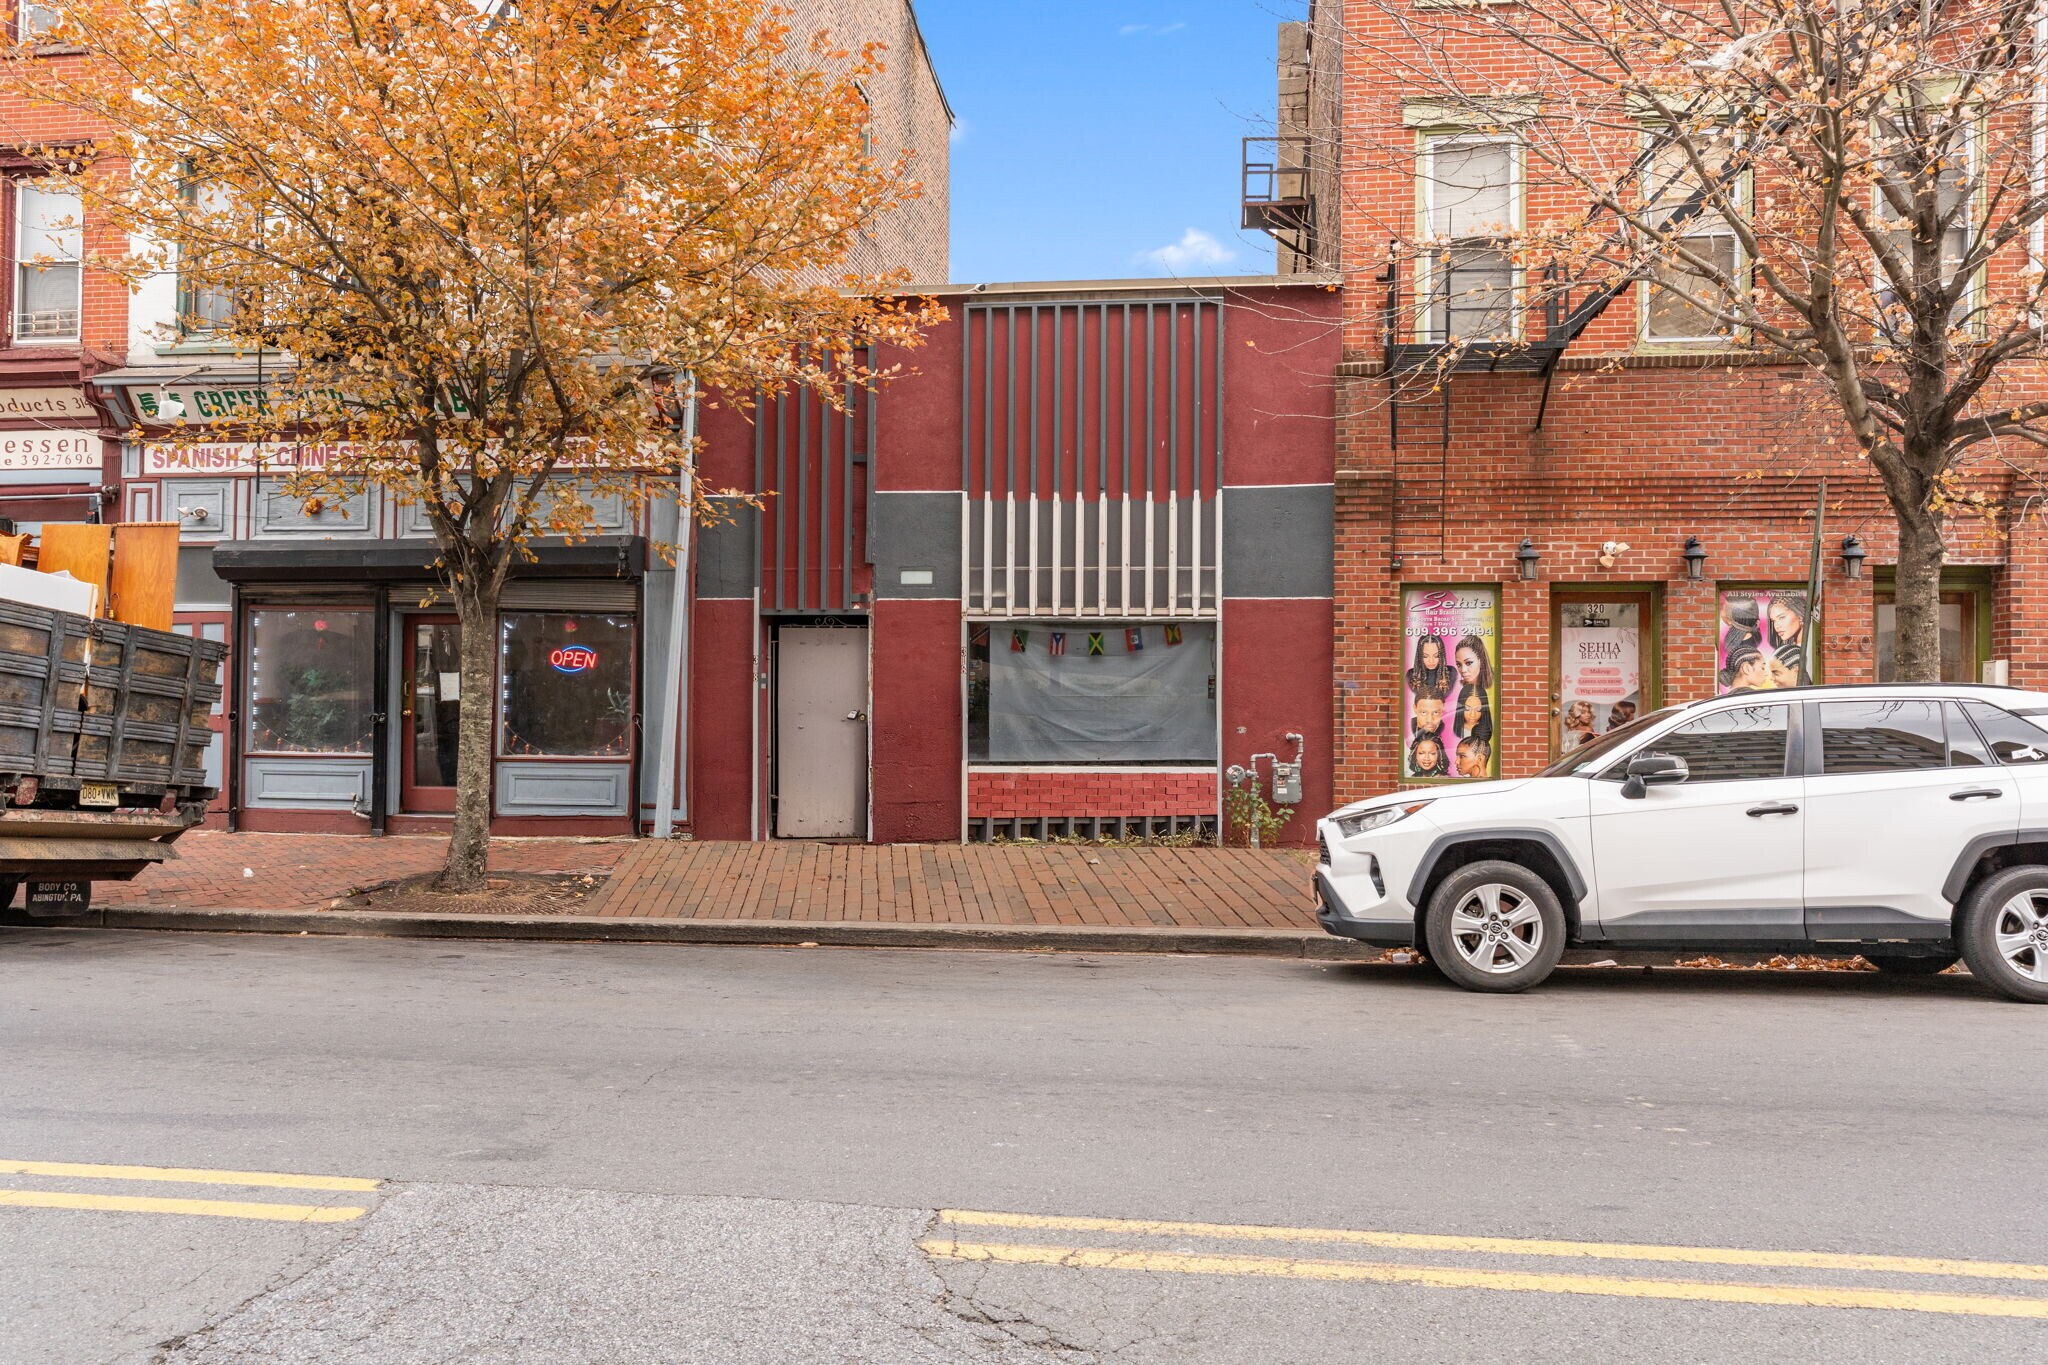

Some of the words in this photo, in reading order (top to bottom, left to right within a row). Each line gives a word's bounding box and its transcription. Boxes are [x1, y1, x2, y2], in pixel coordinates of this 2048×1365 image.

[193, 390, 275, 417] GREEN
[21, 454, 93, 466] 392-7696
[152, 447, 239, 469] SPANISH
[1740, 591, 1764, 599] Styles
[1408, 591, 1493, 612] Sehia
[1587, 604, 1605, 614] 320
[1405, 626, 1429, 636] 609
[1432, 626, 1457, 636] 396
[1461, 626, 1494, 636] 2494
[1578, 642, 1621, 652] SEHIA
[551, 650, 597, 668] OPEN
[1581, 652, 1619, 660] BEAUTY
[38, 883, 61, 891] BODY
